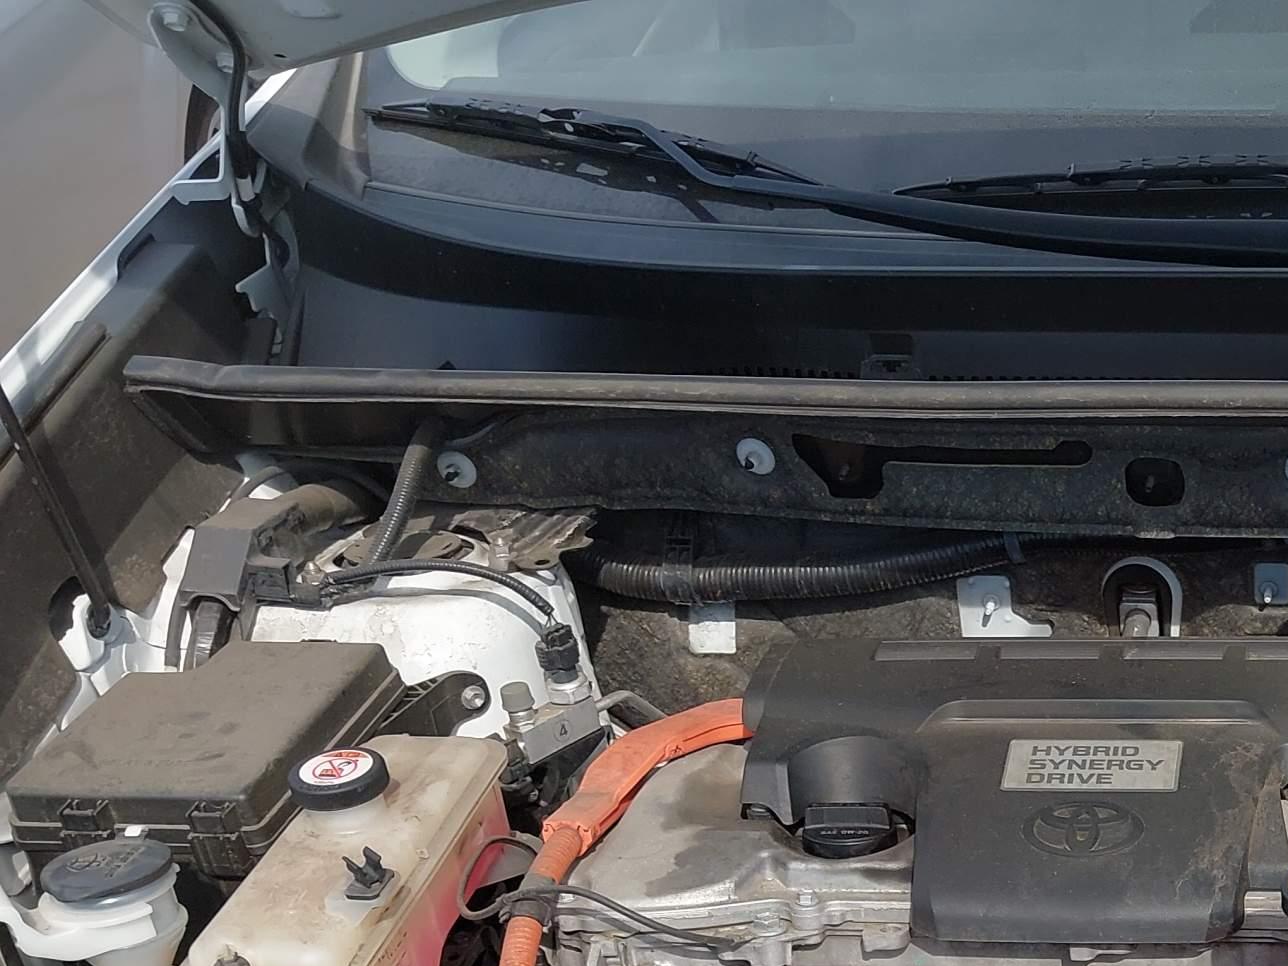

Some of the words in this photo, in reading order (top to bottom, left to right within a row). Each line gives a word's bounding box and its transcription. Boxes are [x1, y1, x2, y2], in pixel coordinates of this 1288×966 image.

[1031, 745, 1140, 757] HYBRID
[1028, 758, 1166, 771] SYNERGY
[1025, 773, 1114, 784] DRIVE
